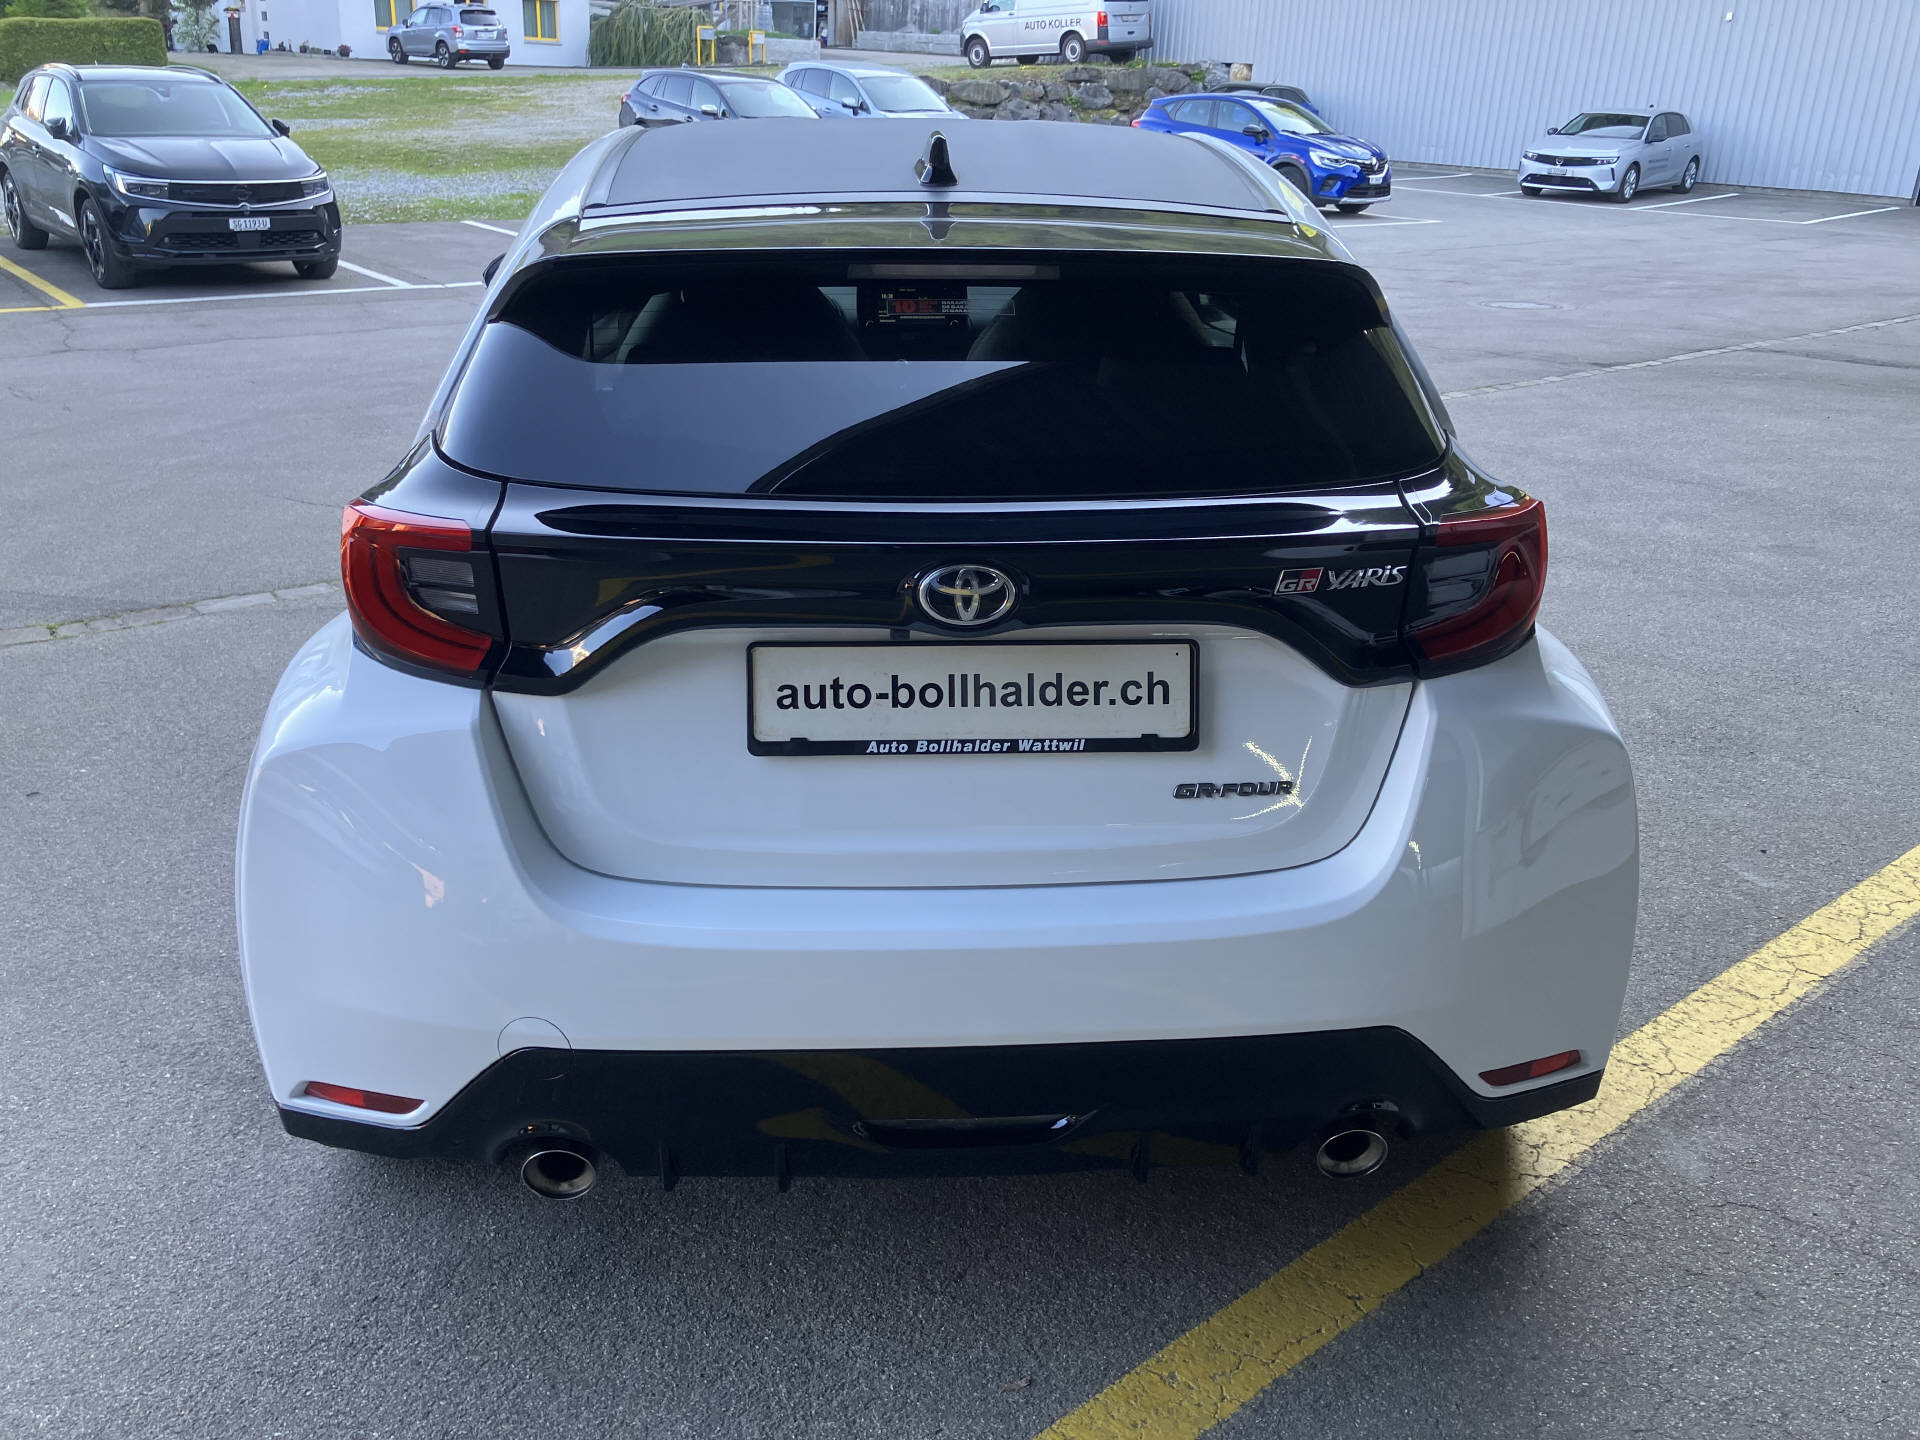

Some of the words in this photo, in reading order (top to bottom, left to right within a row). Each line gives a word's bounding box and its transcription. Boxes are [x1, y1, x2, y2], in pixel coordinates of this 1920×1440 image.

[1024, 21, 1047, 31] AUTO
[1048, 18, 1082, 30] KOLLER
[1279, 578, 1317, 592] GR
[776, 671, 1171, 711] auto-bollhalder.ch
[866, 740, 909, 753] Auto
[915, 739, 1011, 753] Bollhalder
[1018, 738, 1085, 752] Wattwil
